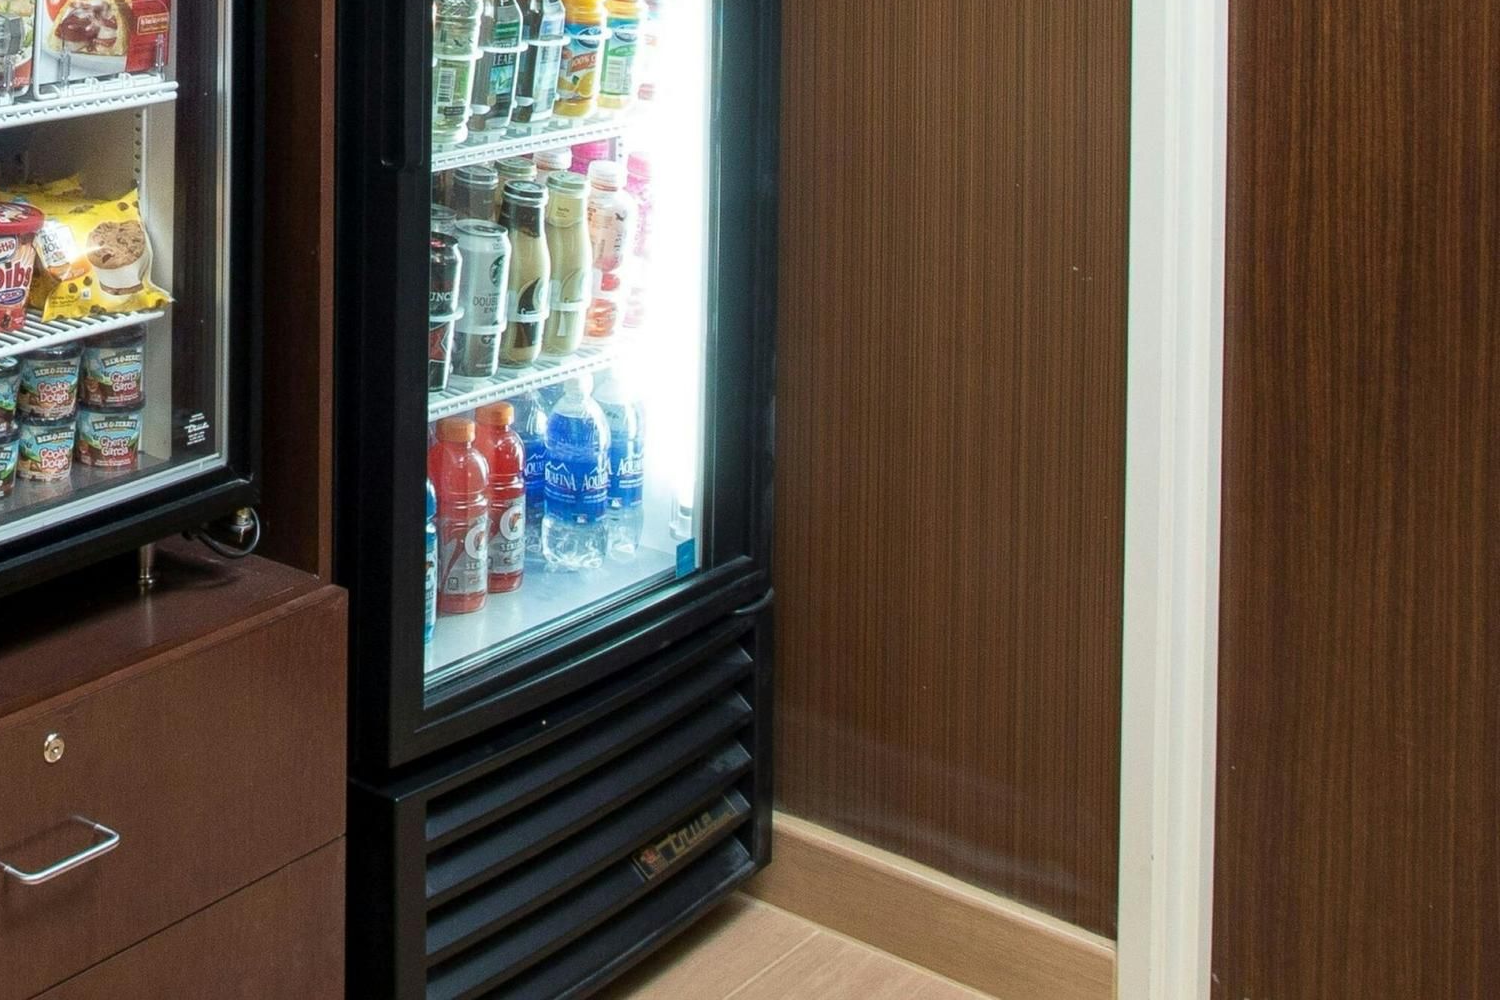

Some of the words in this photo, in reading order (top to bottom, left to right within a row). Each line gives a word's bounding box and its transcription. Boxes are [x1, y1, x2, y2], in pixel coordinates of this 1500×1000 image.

[38, 381, 70, 393] Cookie
[40, 391, 69, 403] Dough
[40, 447, 69, 459] Cookie
[41, 457, 69, 469] Dough
